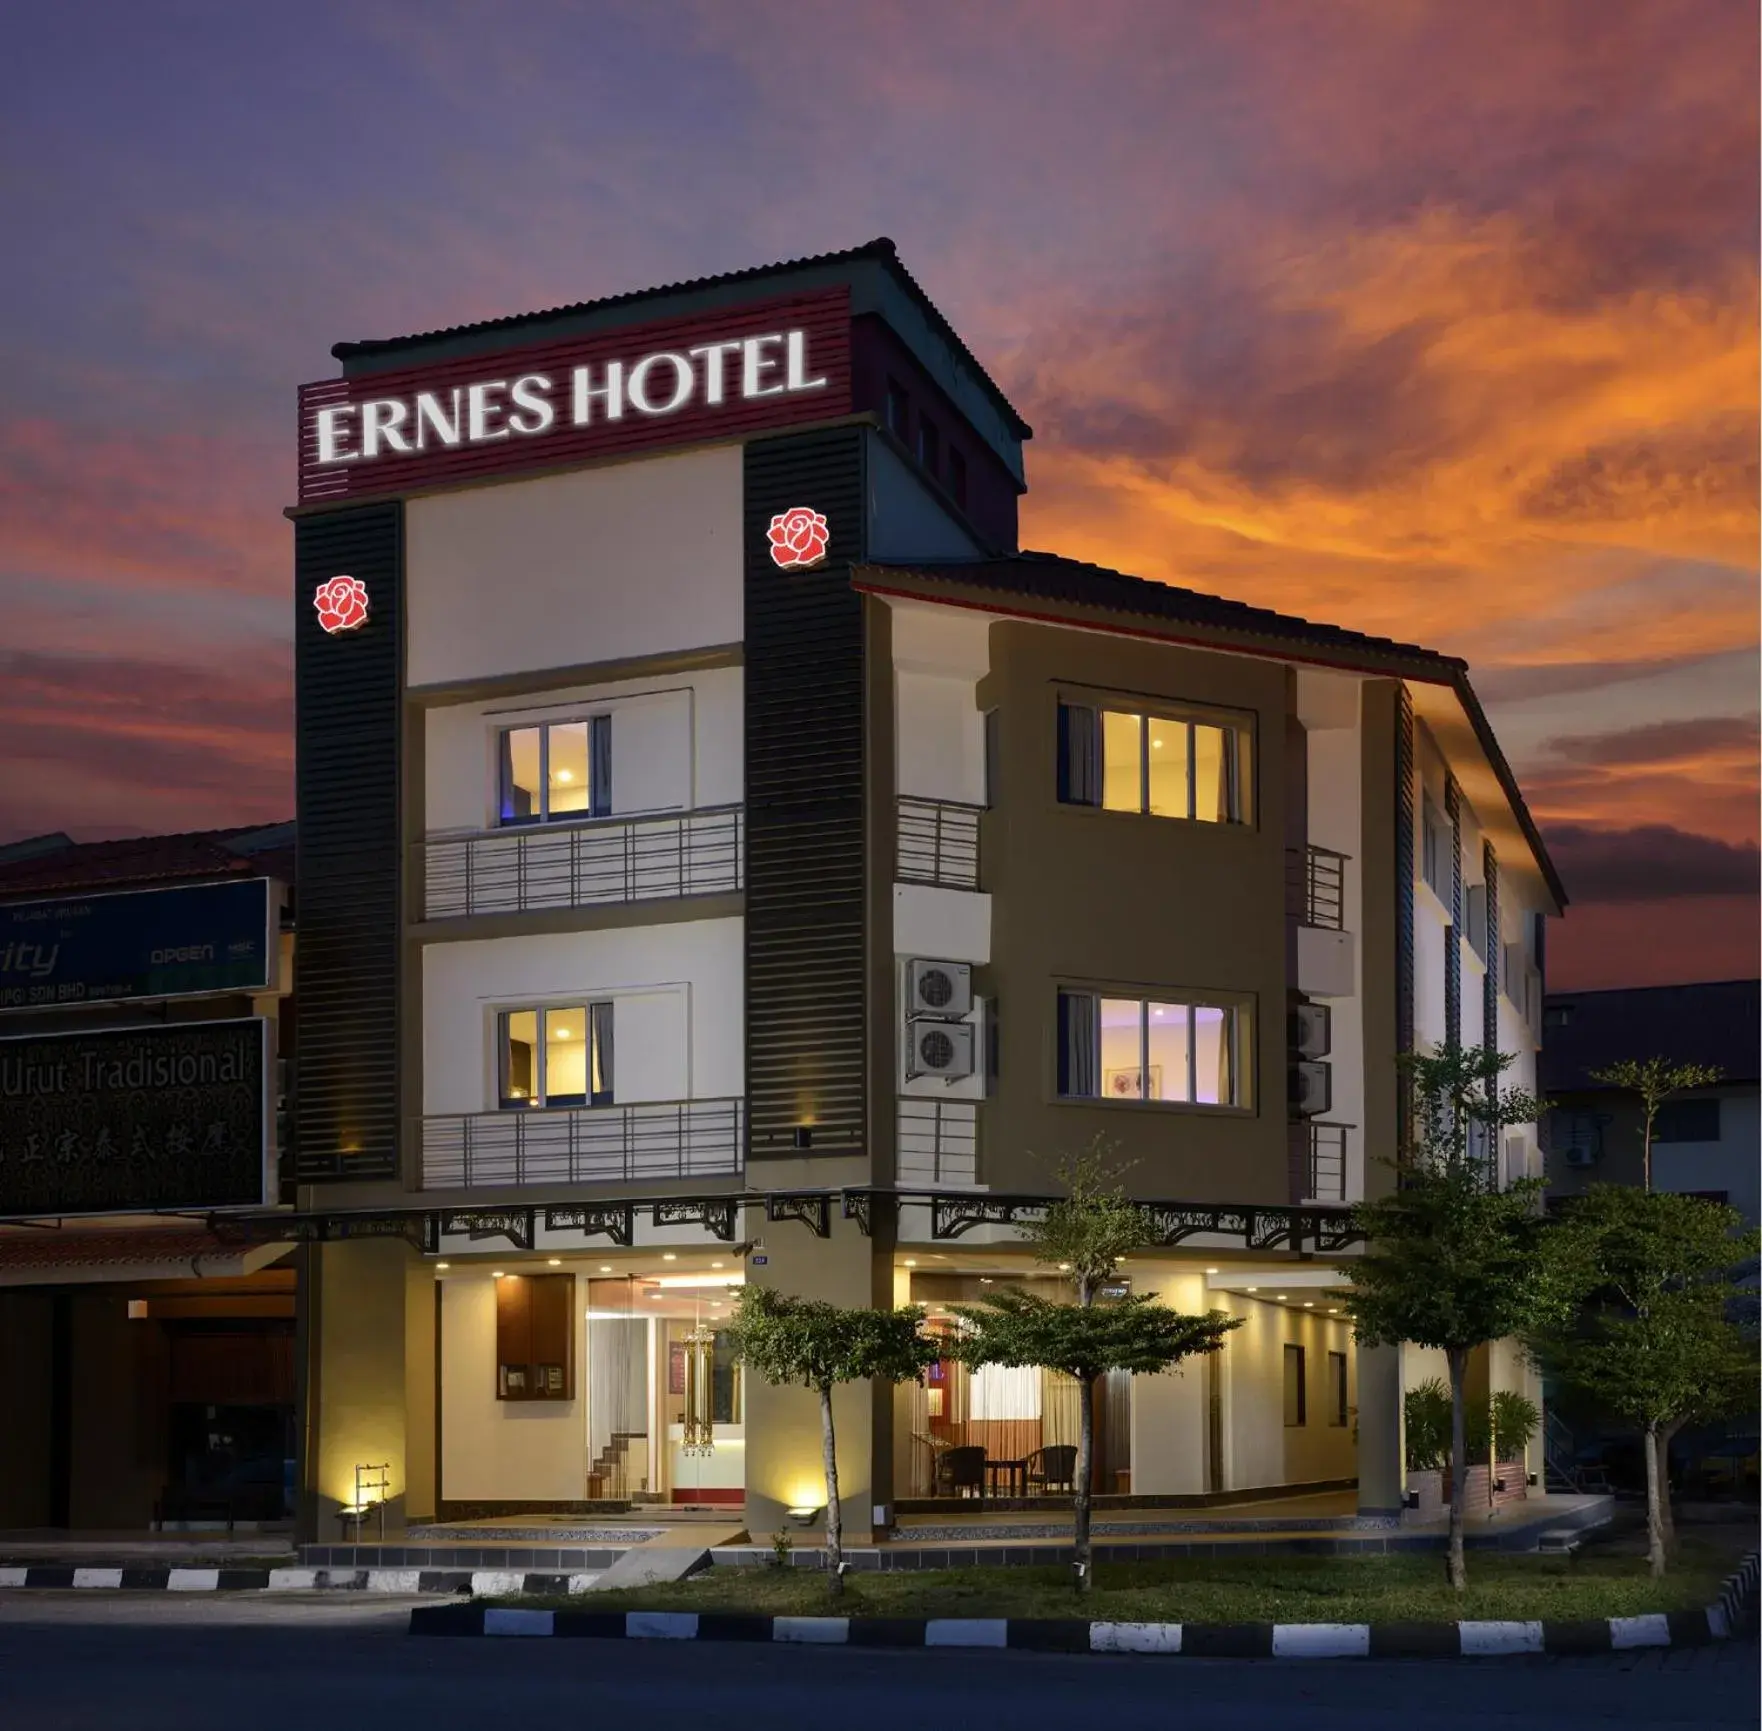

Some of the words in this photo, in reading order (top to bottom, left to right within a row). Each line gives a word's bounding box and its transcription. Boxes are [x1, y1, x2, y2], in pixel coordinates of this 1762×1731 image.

[318, 376, 553, 463] ERNES
[574, 331, 827, 425] HOTEL
[29, 984, 56, 1003] SDN
[58, 981, 85, 1001] BHD
[2, 1057, 68, 1096] Urut
[80, 1043, 245, 1091] Tradisional
[0, 1121, 232, 1163] 正宗泰式按摩
